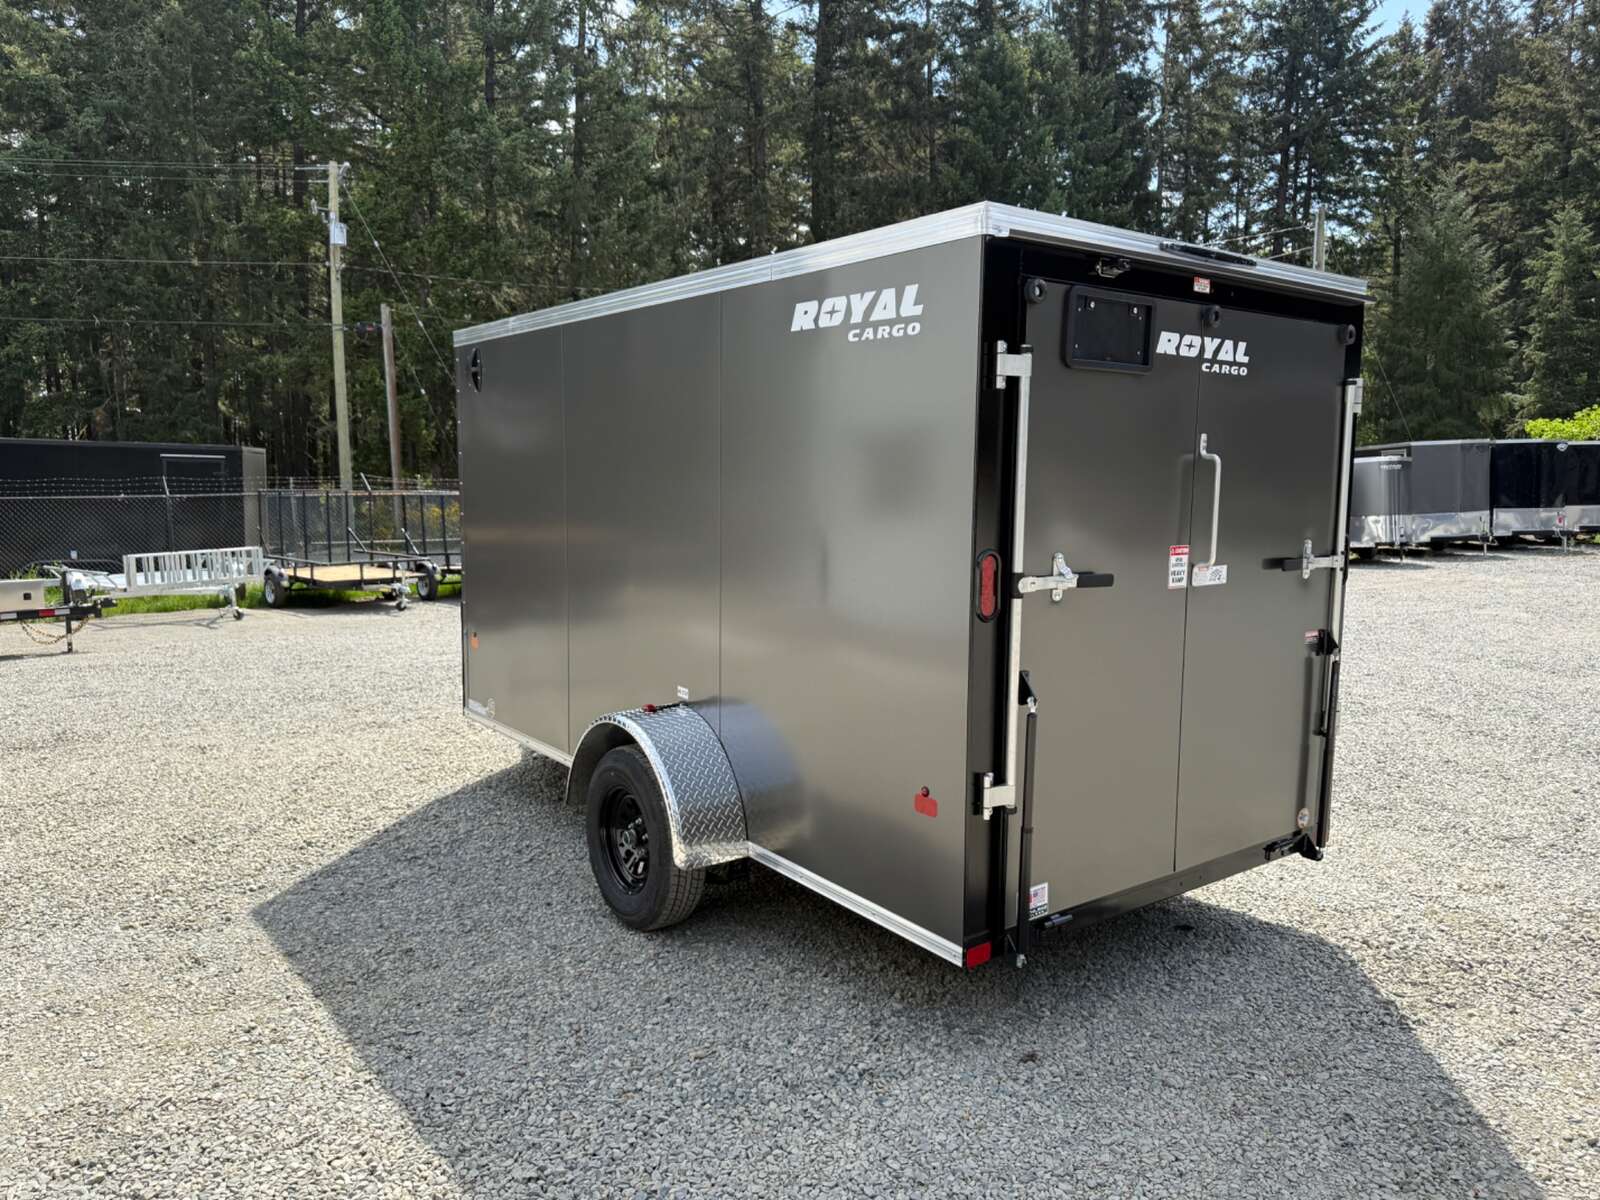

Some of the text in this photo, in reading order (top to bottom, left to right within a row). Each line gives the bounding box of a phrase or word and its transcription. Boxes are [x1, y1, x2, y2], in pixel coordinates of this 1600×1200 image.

[790, 283, 924, 332] ROYAL
[847, 322, 921, 342] CARGO
[1156, 330, 1250, 363] ROYAL
[1201, 362, 1248, 376] CARGO
